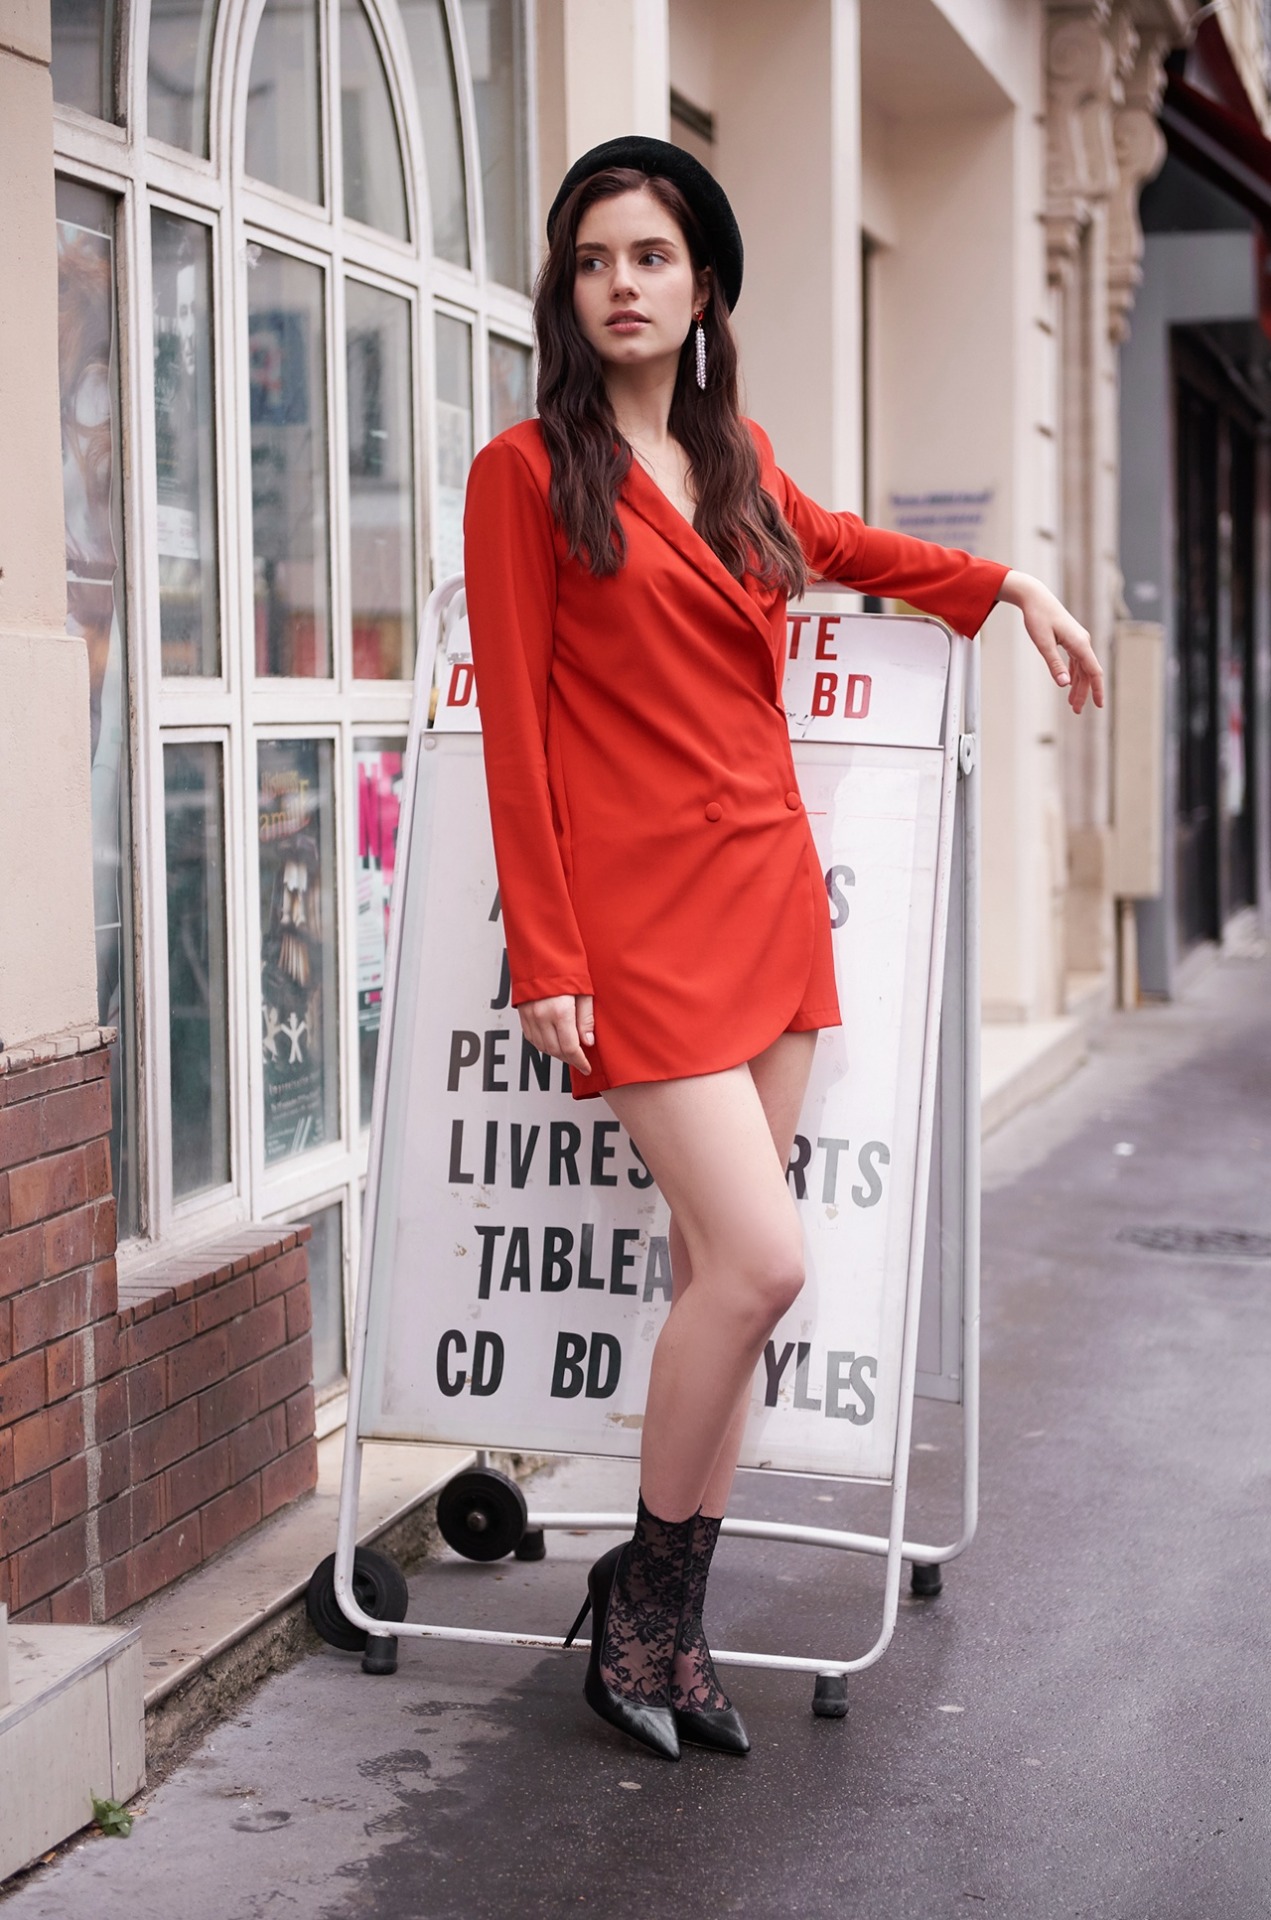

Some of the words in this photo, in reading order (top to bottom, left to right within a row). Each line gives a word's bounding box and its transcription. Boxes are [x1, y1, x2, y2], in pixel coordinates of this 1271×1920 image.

[811, 672, 872, 719] BD
[447, 1030, 573, 1093] PEN
[436, 1329, 505, 1398] CD
[550, 1331, 622, 1400] BD
